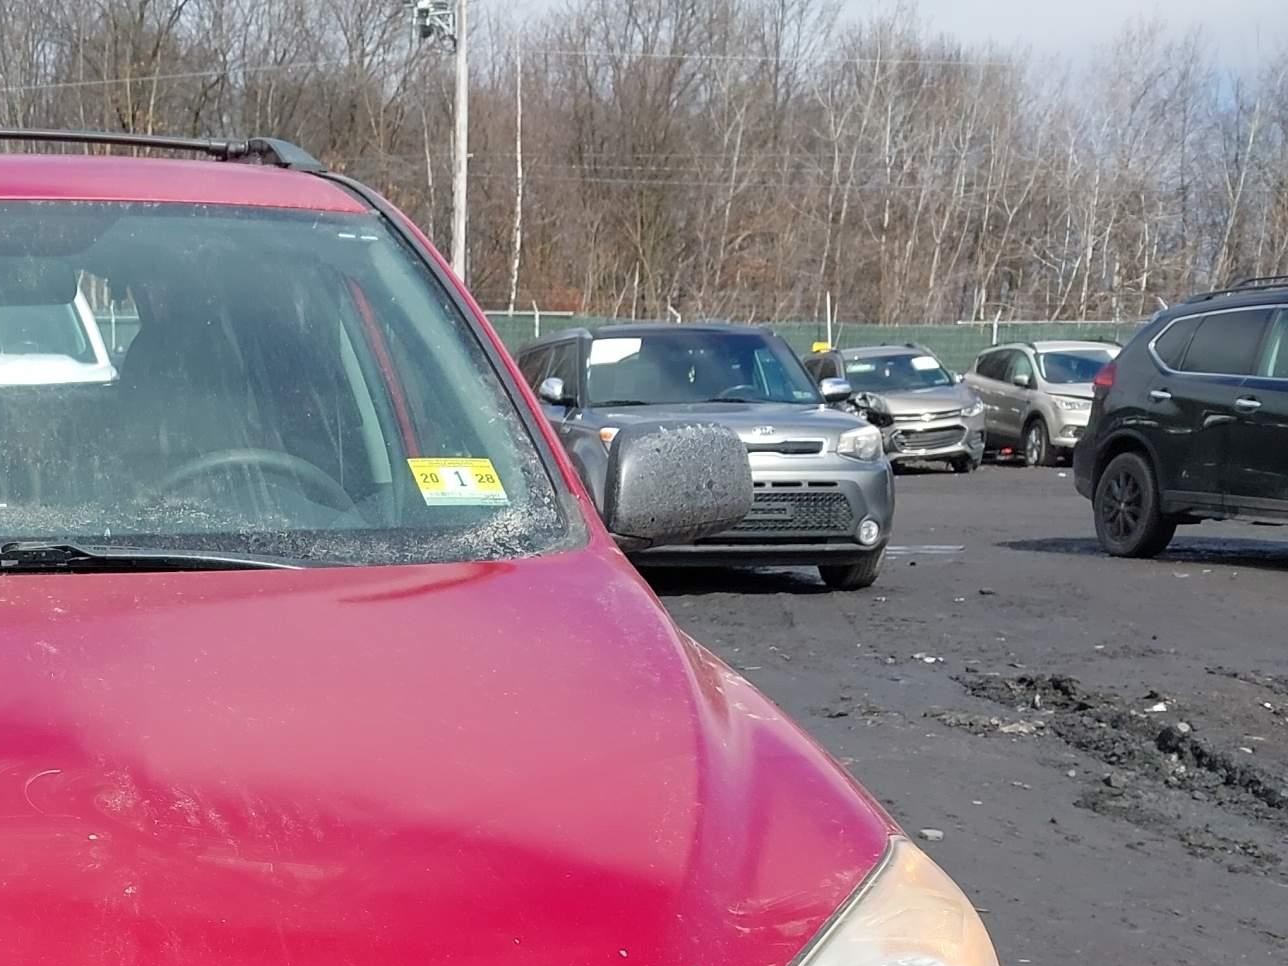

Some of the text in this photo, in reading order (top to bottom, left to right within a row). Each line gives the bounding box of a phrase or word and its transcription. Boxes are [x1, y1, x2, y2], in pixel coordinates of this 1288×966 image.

[419, 470, 496, 487] 20 1 28
